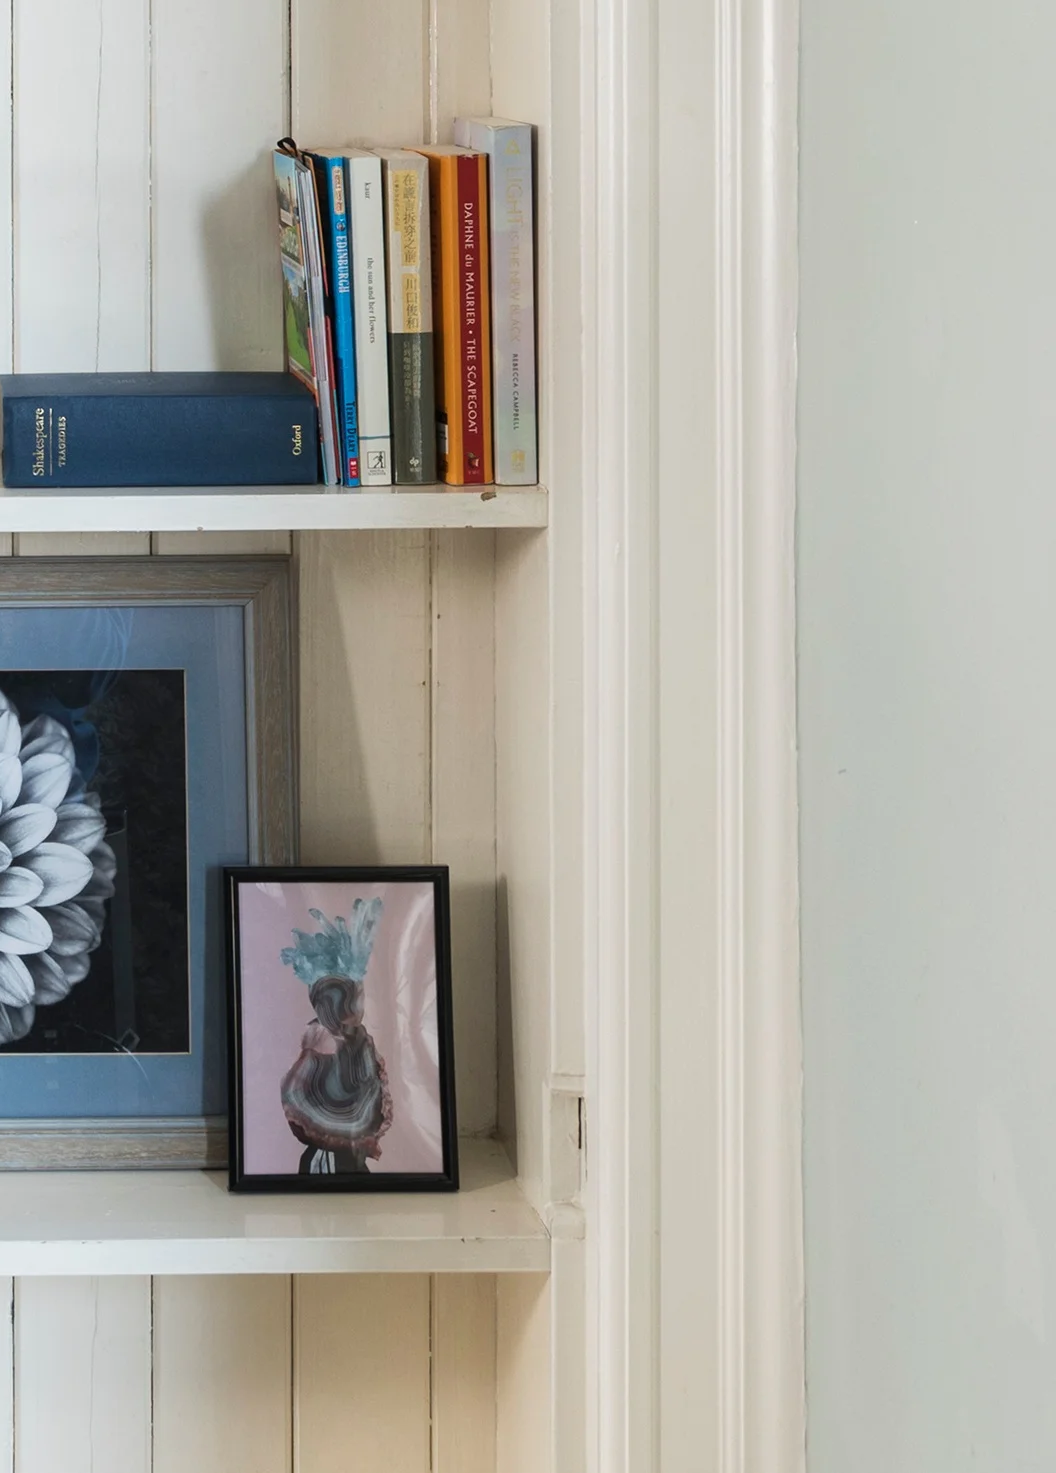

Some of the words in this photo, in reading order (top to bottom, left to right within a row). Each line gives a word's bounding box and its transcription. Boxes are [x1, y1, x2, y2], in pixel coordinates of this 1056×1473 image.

[505, 167, 525, 227] LIGHT
[464, 202, 474, 250] DAPHNE
[509, 230, 519, 243] IS
[336, 235, 349, 293] EDINBURGH
[367, 257, 375, 269] the
[465, 254, 474, 267] du
[509, 246, 519, 268] THE
[367, 270, 375, 285] sun
[509, 271, 520, 302] NEW
[368, 286, 376, 300] and
[368, 301, 376, 314] her
[465, 272, 476, 325] MAURIER
[368, 315, 377, 344] flowers
[509, 304, 521, 342] BLACK
[466, 339, 476, 360] THE
[346, 401, 356, 426] TERRY
[467, 365, 478, 434] SCAPEGOAT
[512, 391, 520, 430] CAMPBELL
[32, 408, 47, 477] Shakespeare
[58, 415, 67, 468] TRAGEDIES
[292, 424, 302, 456] Oxford
[346, 427, 358, 453] DEARY
